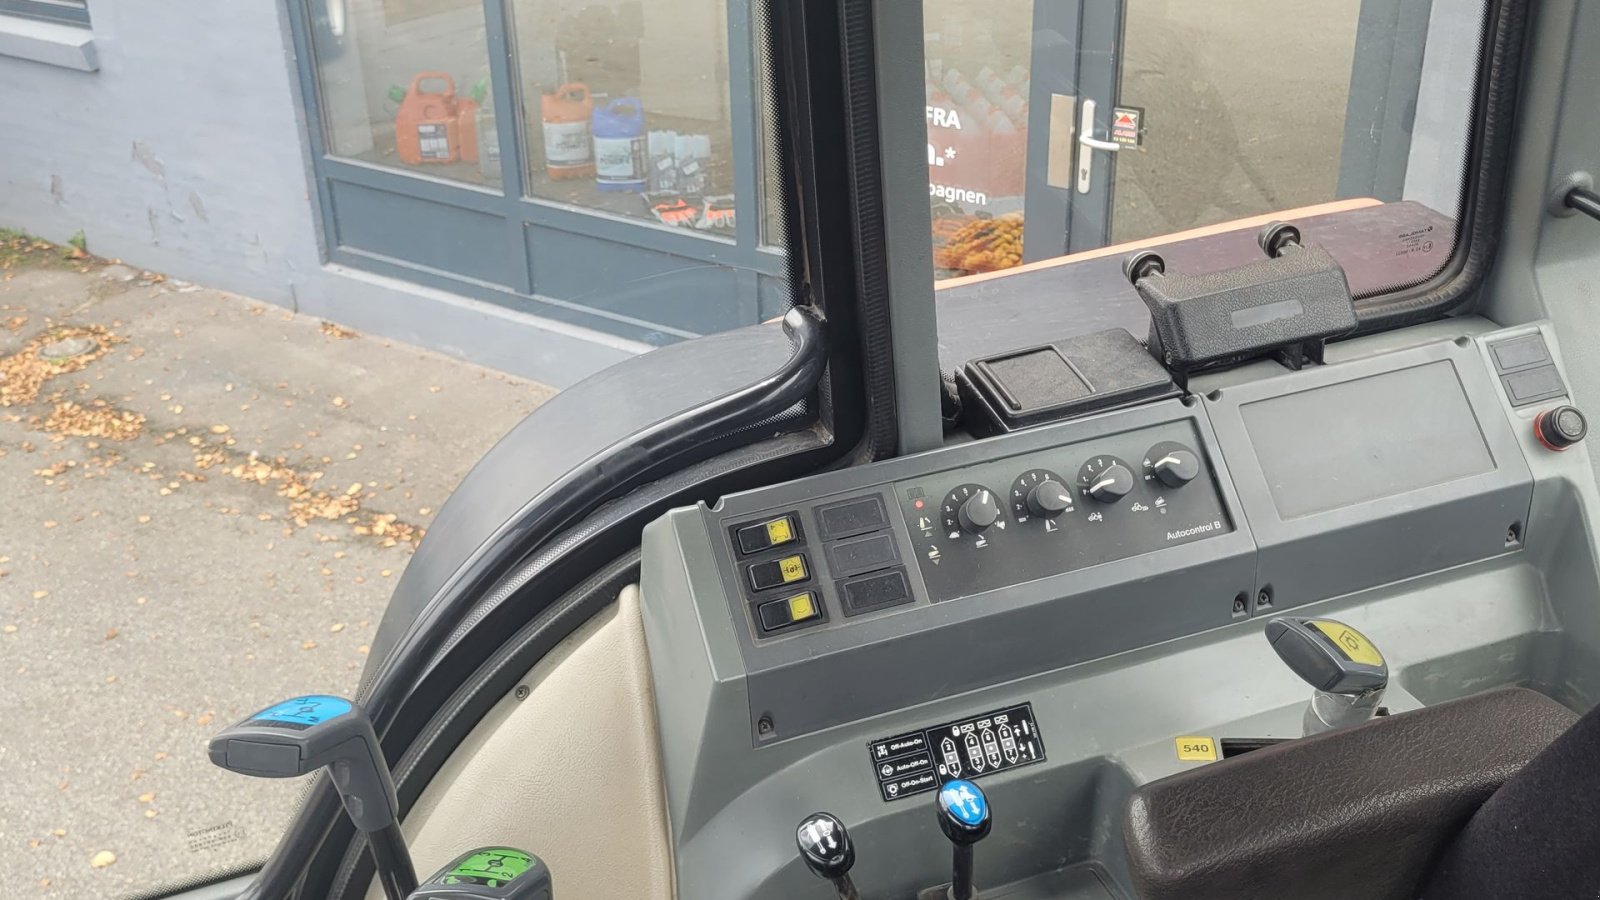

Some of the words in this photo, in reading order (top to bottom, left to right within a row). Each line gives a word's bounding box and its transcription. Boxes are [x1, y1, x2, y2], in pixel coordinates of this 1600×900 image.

[1166, 522, 1213, 540] Autocontrol
[1213, 520, 1222, 529] B
[890, 738, 923, 750] Off-Auto-On
[1183, 744, 1209, 753] 540
[896, 759, 929, 771] Auto-Off-On
[901, 775, 934, 788] Off-On-Start
